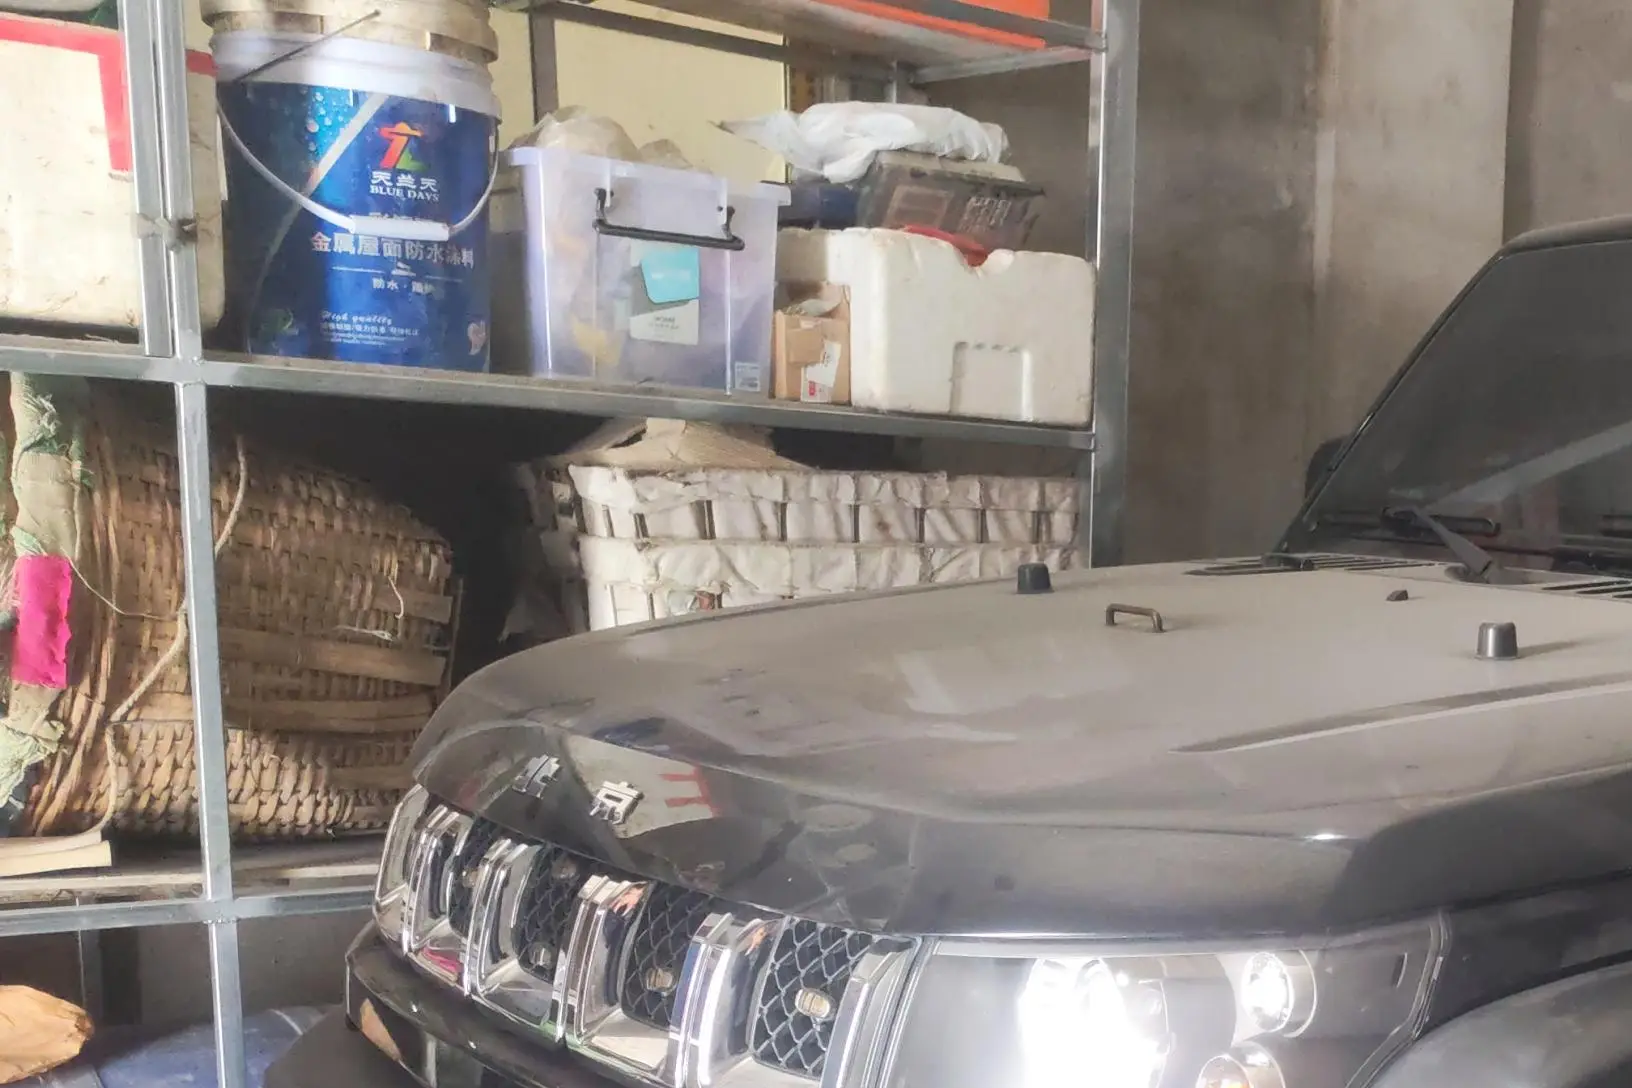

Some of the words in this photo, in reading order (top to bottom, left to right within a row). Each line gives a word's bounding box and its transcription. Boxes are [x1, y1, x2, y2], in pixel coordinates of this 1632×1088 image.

[369, 184, 404, 199] BLUE
[407, 189, 440, 202] DAYS
[311, 231, 474, 270] 金属屋面防水涂料
